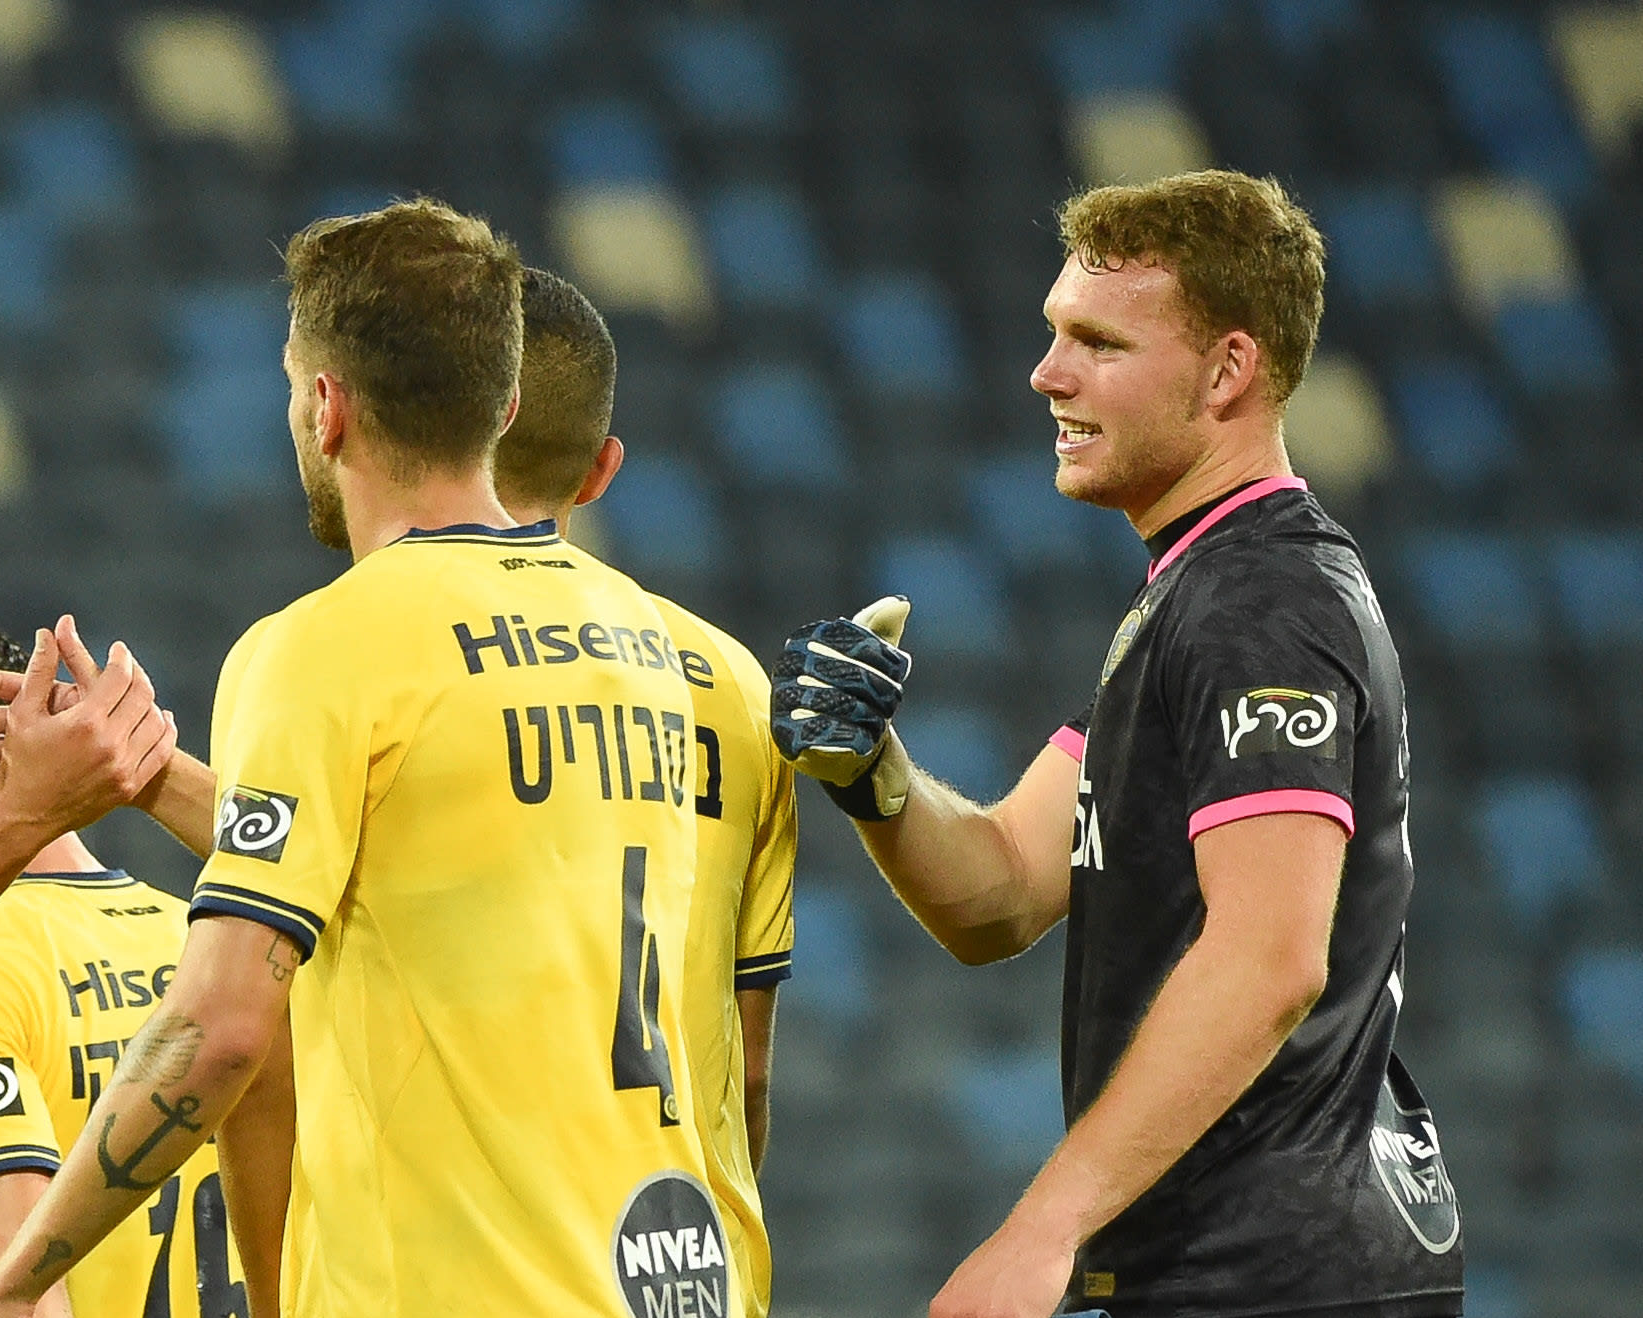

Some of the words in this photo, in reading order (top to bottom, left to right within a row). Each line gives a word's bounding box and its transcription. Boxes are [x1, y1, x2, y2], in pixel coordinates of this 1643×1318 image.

[59, 959, 177, 1018] Hise
[611, 846, 681, 1128] 4
[621, 1223, 726, 1279] NIVEA
